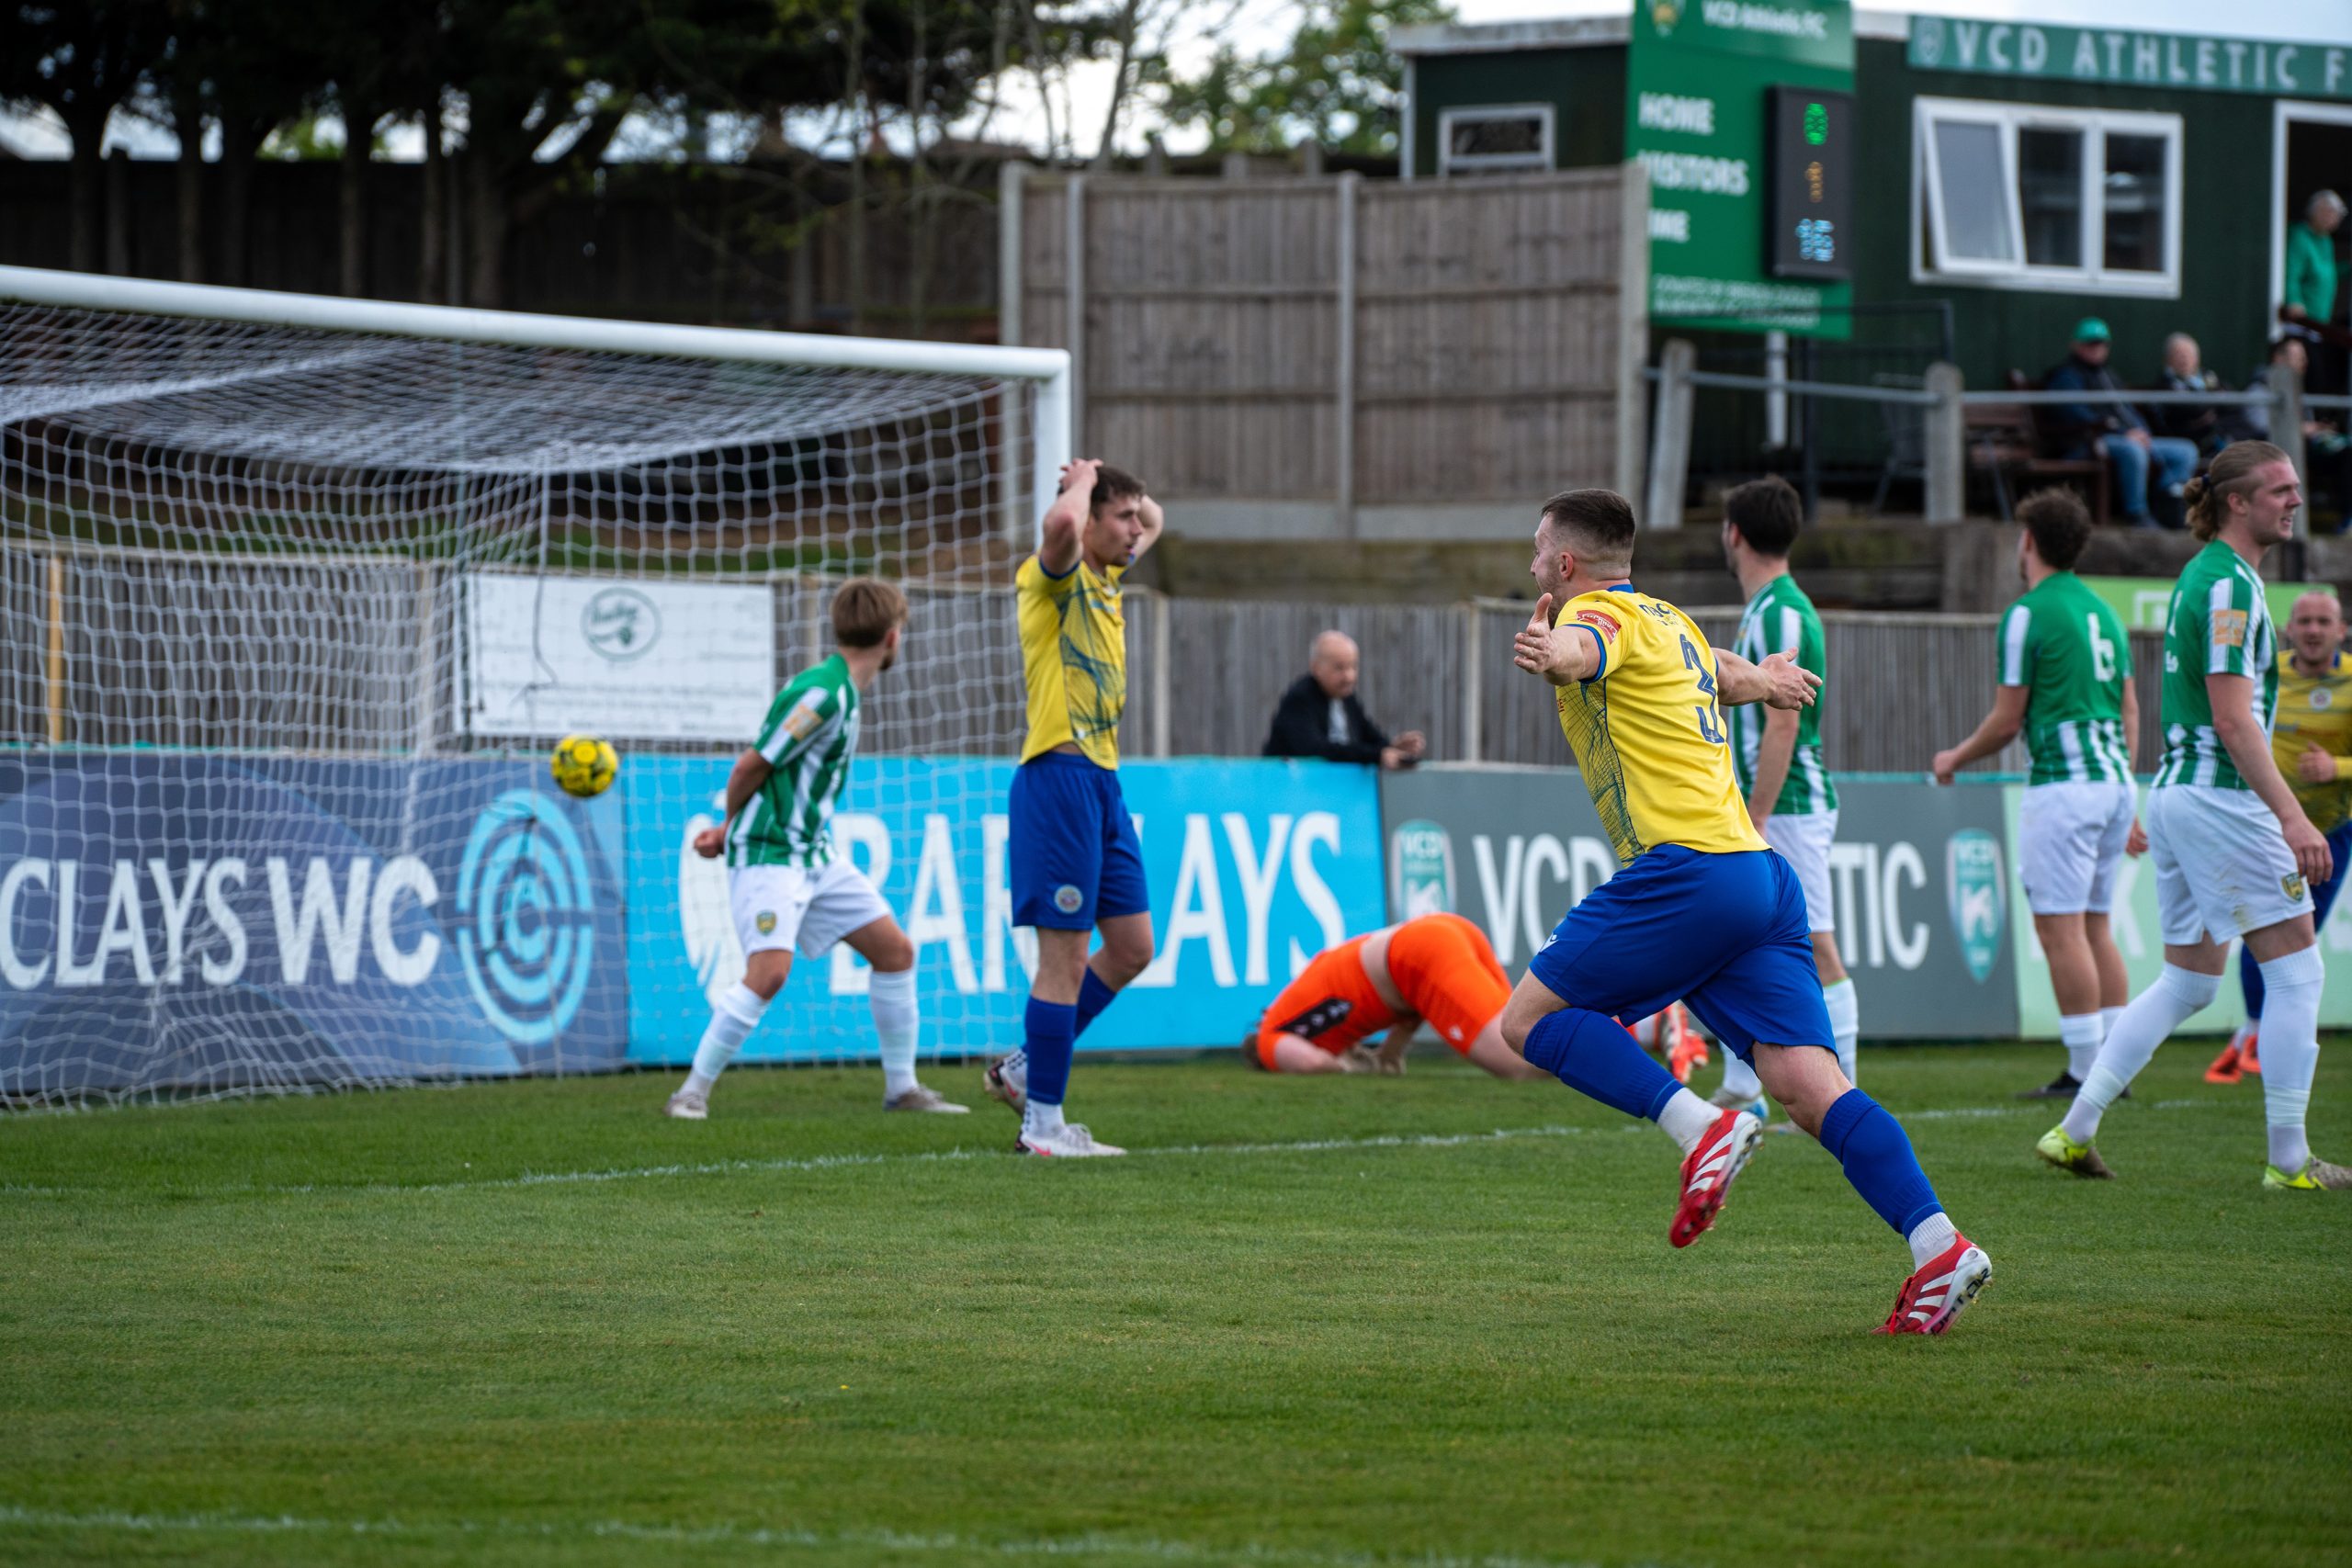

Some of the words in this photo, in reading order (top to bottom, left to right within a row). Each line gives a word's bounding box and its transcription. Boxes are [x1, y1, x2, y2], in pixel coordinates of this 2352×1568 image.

[1955, 22, 2049, 73] VCD
[2072, 30, 2299, 90] ATHLETIC
[1638, 93, 1715, 134] HOME
[1649, 209, 1690, 242] IME
[2087, 612, 2116, 682] 6
[1679, 633, 1725, 744] 3
[0, 856, 248, 990] CLAYS
[266, 855, 441, 987] WC
[829, 811, 1346, 995] BARAYS
